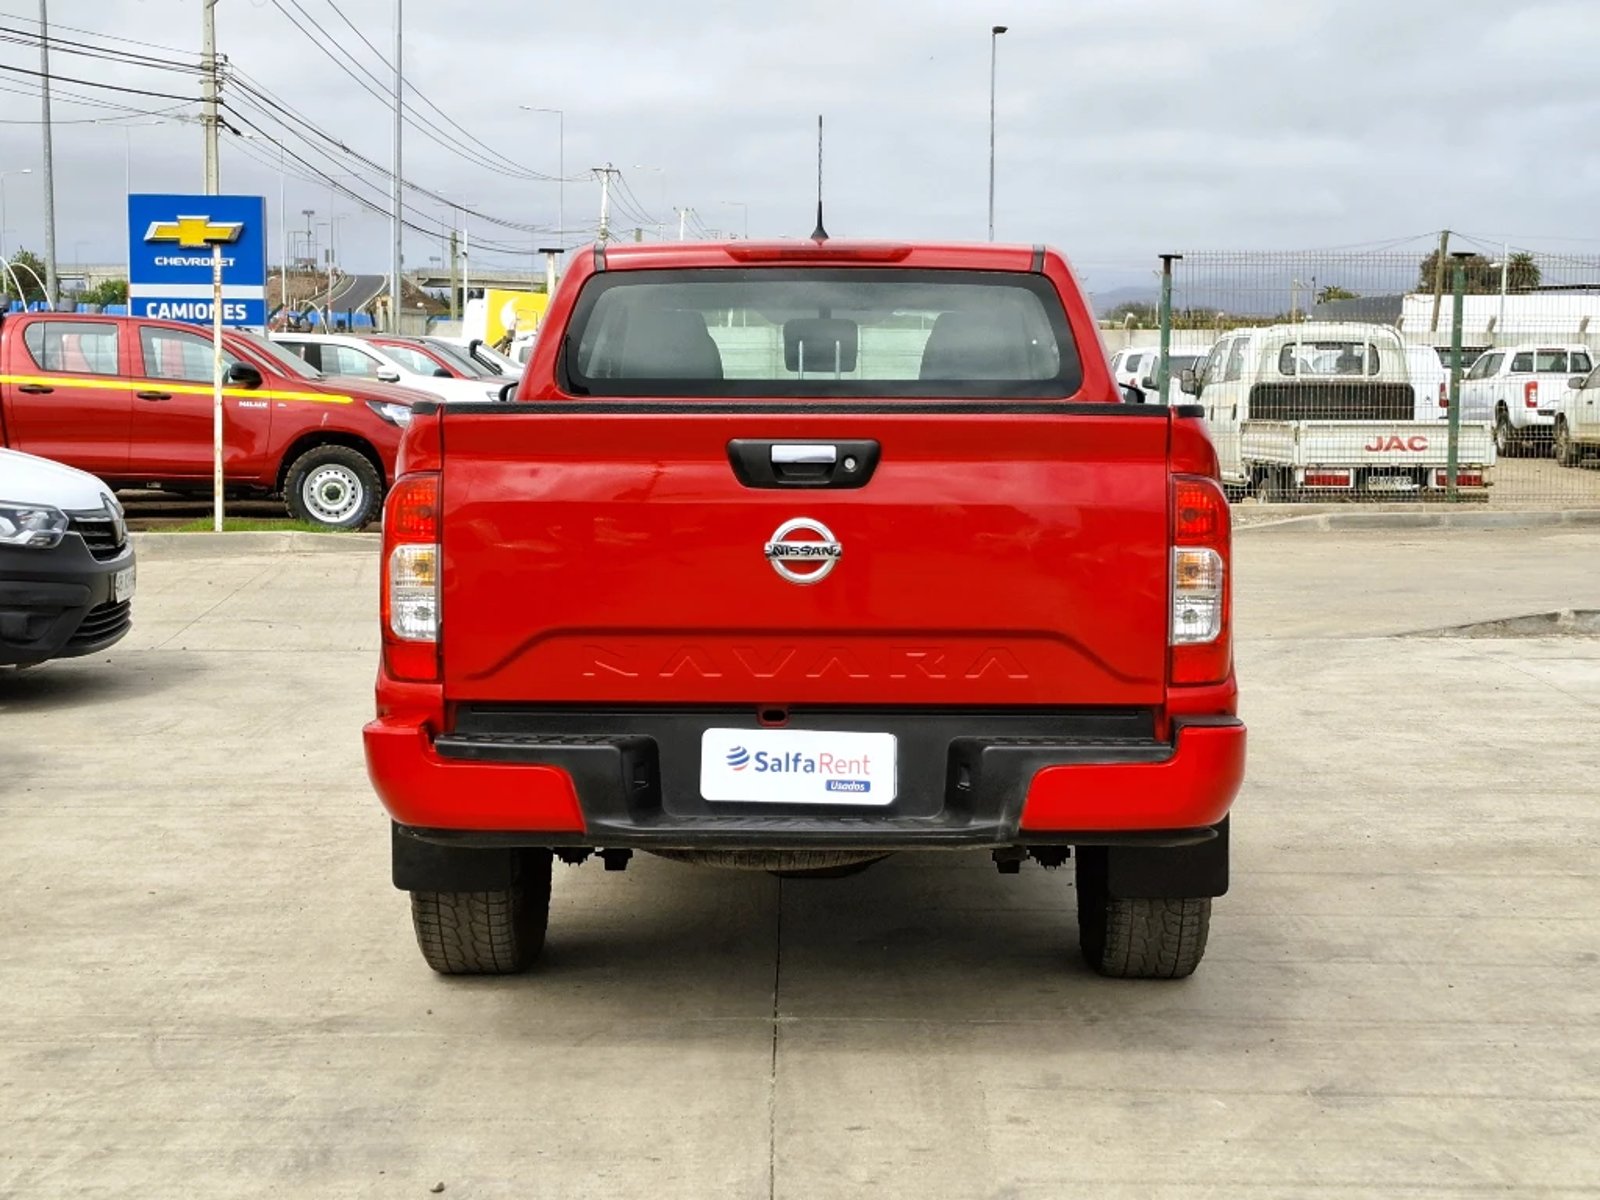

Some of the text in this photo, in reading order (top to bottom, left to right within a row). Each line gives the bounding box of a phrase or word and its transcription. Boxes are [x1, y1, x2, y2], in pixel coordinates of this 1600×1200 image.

[1365, 435, 1428, 453] JAC
[772, 545, 834, 557] NISSAN
[583, 645, 1029, 679] NAVARA
[830, 781, 866, 792] Usados
